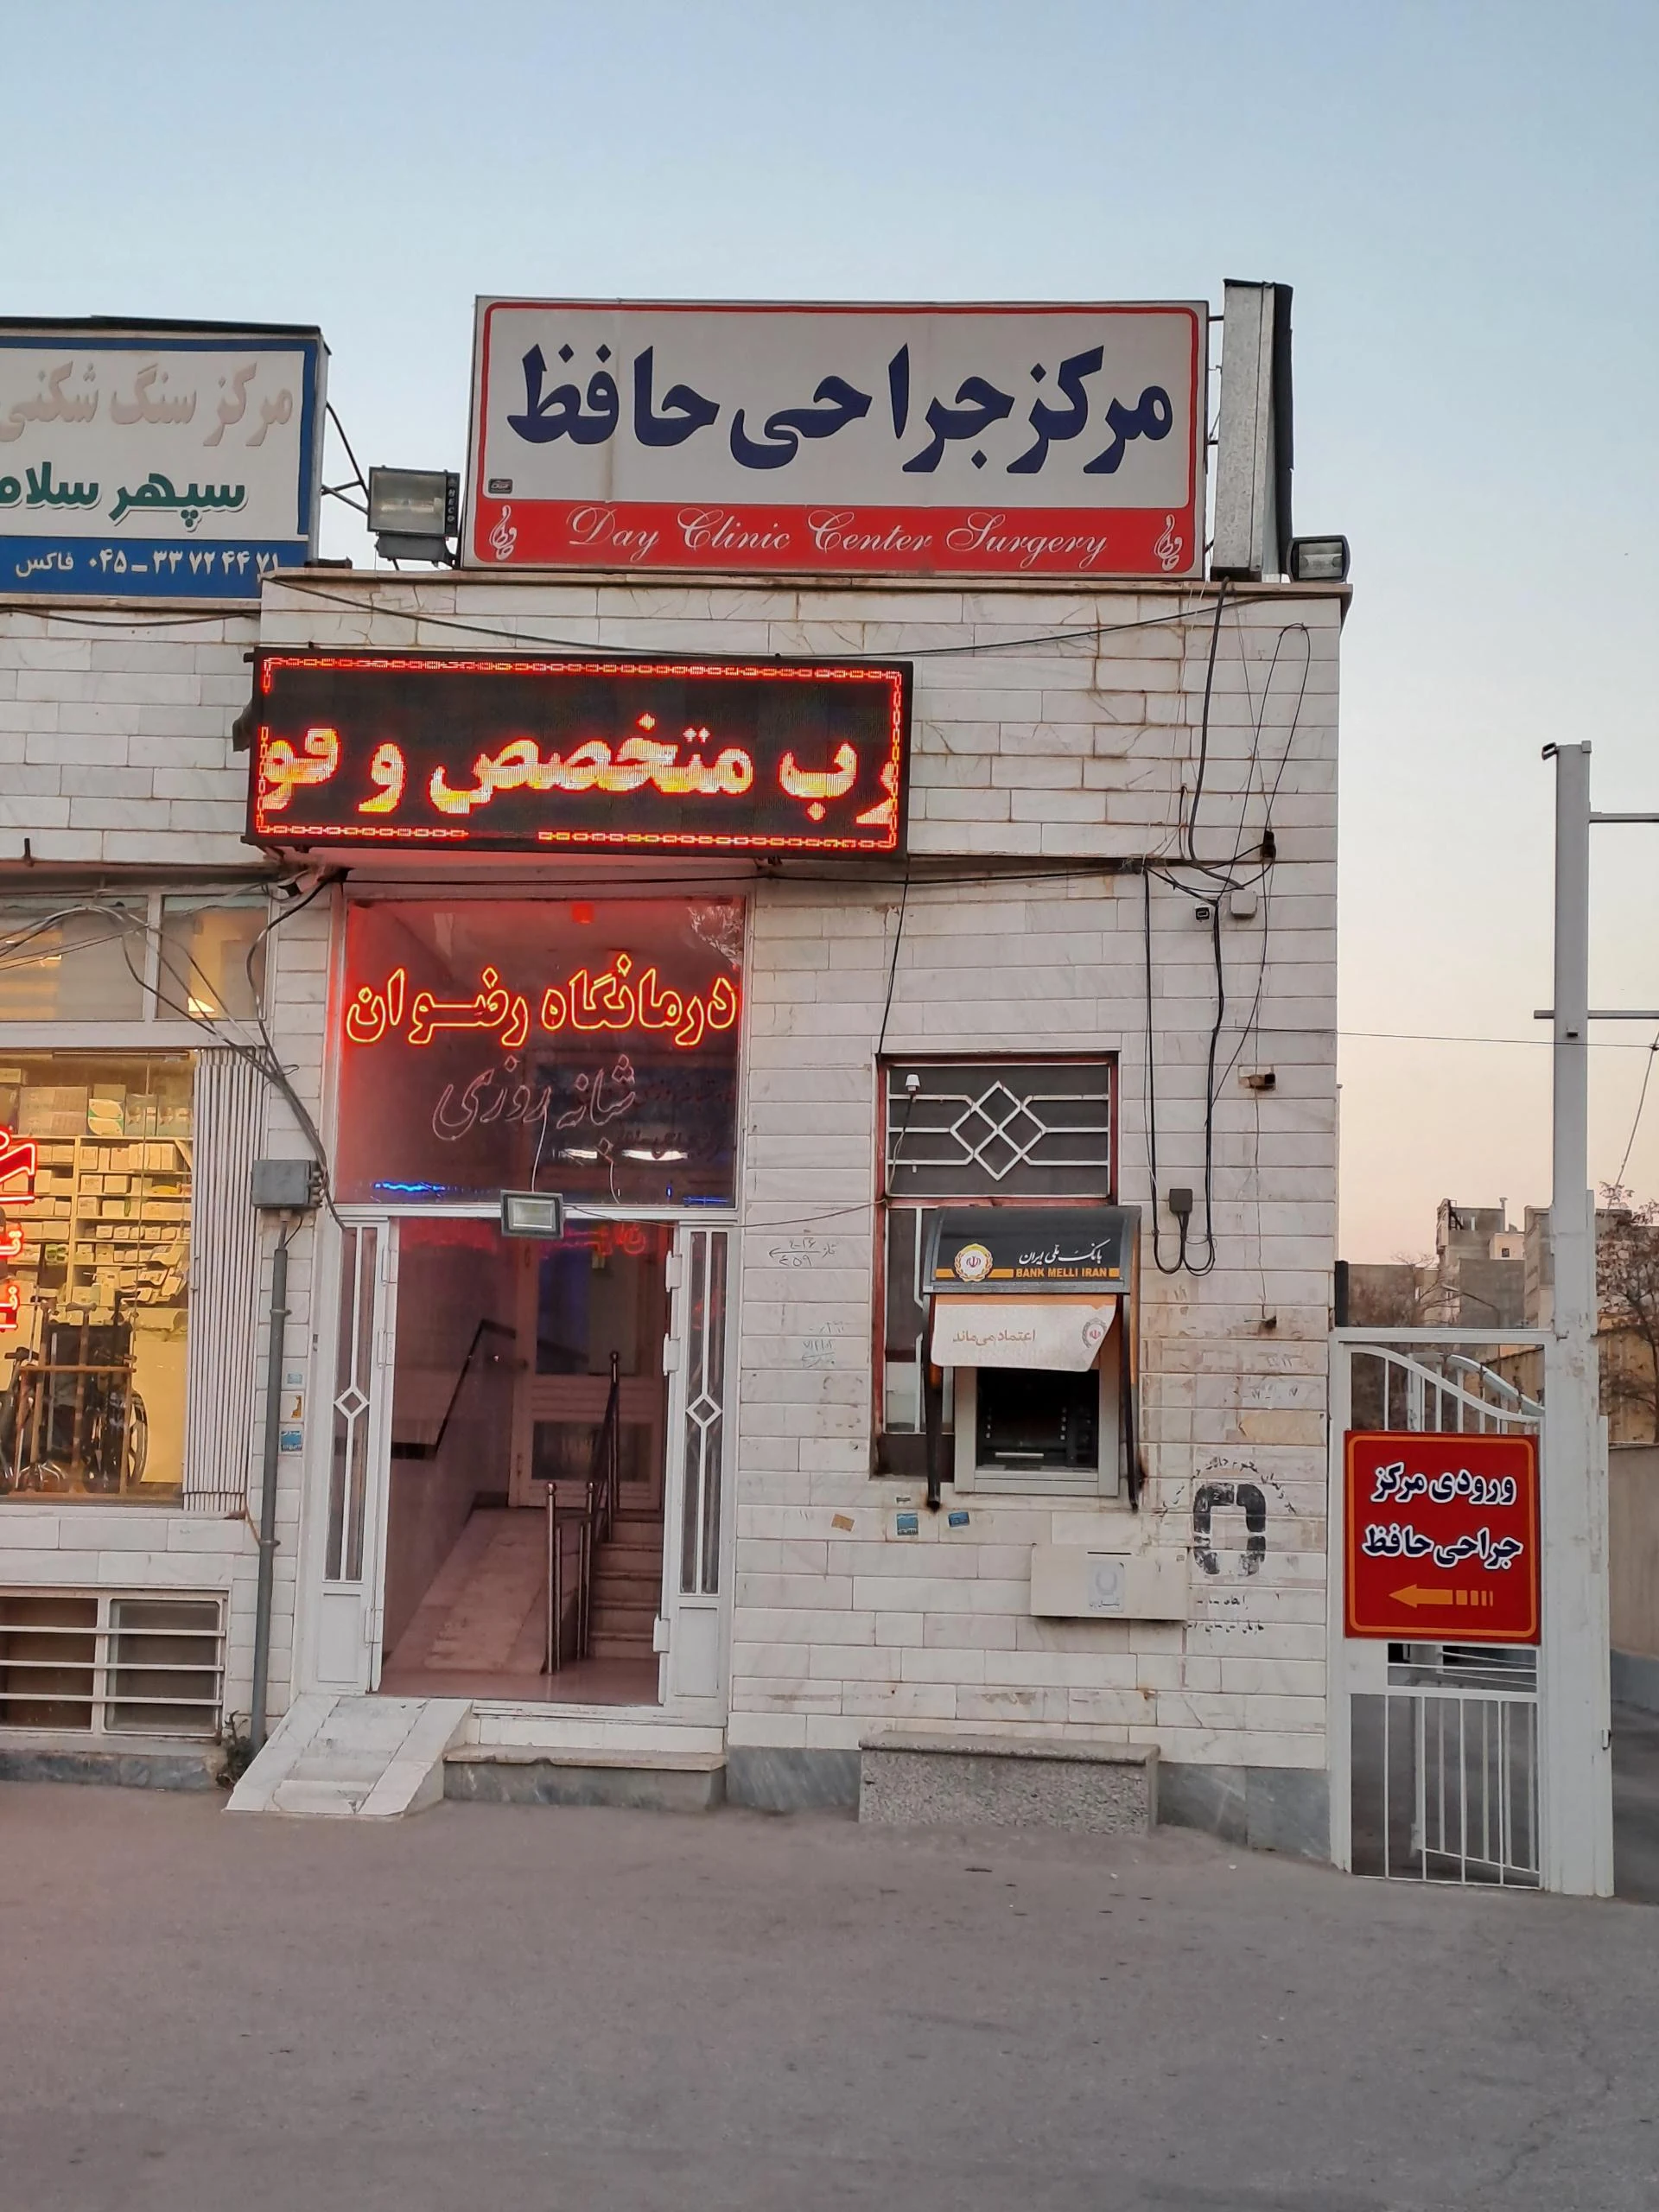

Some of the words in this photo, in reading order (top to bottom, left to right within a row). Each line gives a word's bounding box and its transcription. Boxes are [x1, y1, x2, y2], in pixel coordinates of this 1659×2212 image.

[0, 359, 100, 443] شکنی
[110, 362, 198, 425] سنگ
[203, 359, 294, 448] مرکز
[506, 344, 721, 448] حافظ
[730, 343, 1015, 474] جراحی
[1008, 347, 1173, 475] مرکز
[107, 472, 249, 532] سپهر
[15, 551, 75, 578] فاکس
[566, 505, 659, 559] Day
[676, 509, 791, 550] Clinic
[807, 510, 933, 554] Center
[945, 514, 1108, 567] Surgery
[357, 742, 406, 814] و
[429, 711, 754, 816] متخصص
[346, 965, 530, 1046] رضوان
[540, 952, 737, 1047] درمانگاه
[1014, 1267, 1045, 1279] BANK
[1046, 1267, 1078, 1279] MELLI
[1081, 1267, 1108, 1279] IRAN
[1017, 1250, 1046, 1266] ایران
[1044, 1244, 1060, 1264] ملی
[1059, 1237, 1111, 1265] بانک
[997, 1329, 1036, 1343] اعتماد
[1370, 1461, 1427, 1503] مرکز
[1428, 1468, 1517, 1506] ورودی
[1361, 1522, 1435, 1558] حافظ
[1433, 1527, 1524, 1570] جراحی
